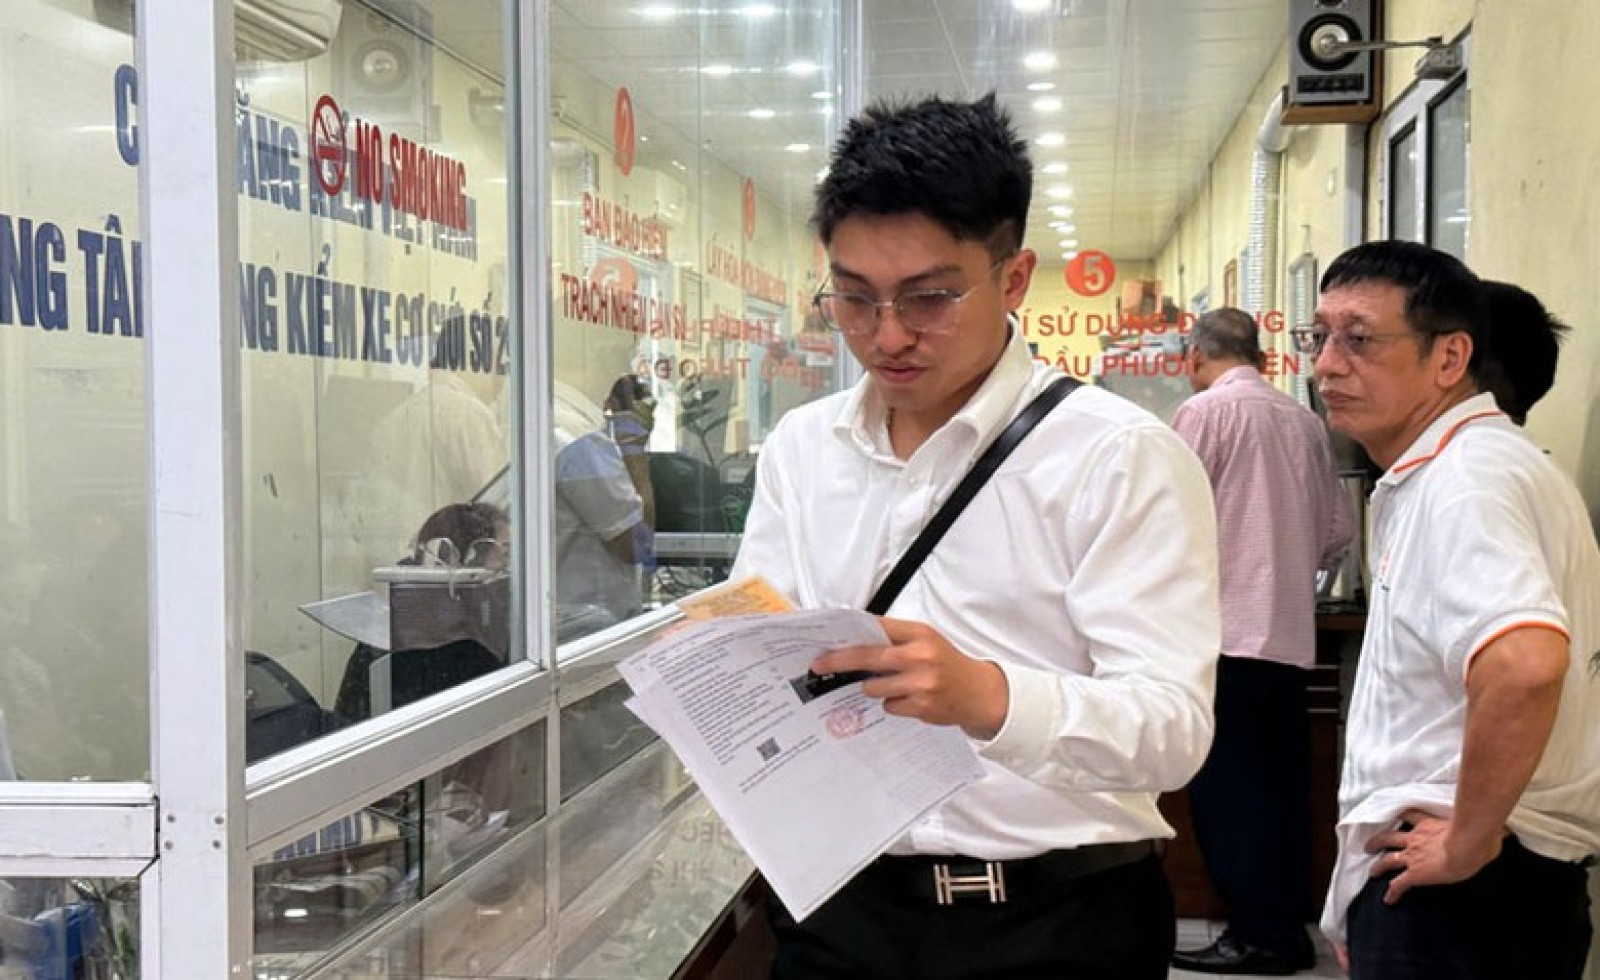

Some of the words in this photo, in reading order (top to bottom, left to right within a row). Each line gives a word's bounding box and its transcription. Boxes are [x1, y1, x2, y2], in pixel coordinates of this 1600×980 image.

[114, 64, 140, 167] C
[238, 88, 302, 213] ĂNG
[355, 117, 383, 205] NO
[390, 132, 467, 233] SMOKING
[0, 214, 68, 331] NG
[239, 262, 279, 353] NG
[284, 243, 358, 361] KIỂM
[360, 286, 393, 364] XE
[395, 291, 425, 368] CƠ
[469, 291, 494, 374] SỐ
[495, 315, 509, 376] 2
[1037, 305, 1078, 337] SỬ
[1086, 311, 1169, 340] DỤNG
[1034, 346, 1092, 377] ẦU
[1101, 351, 1194, 377] PHƯƠ
